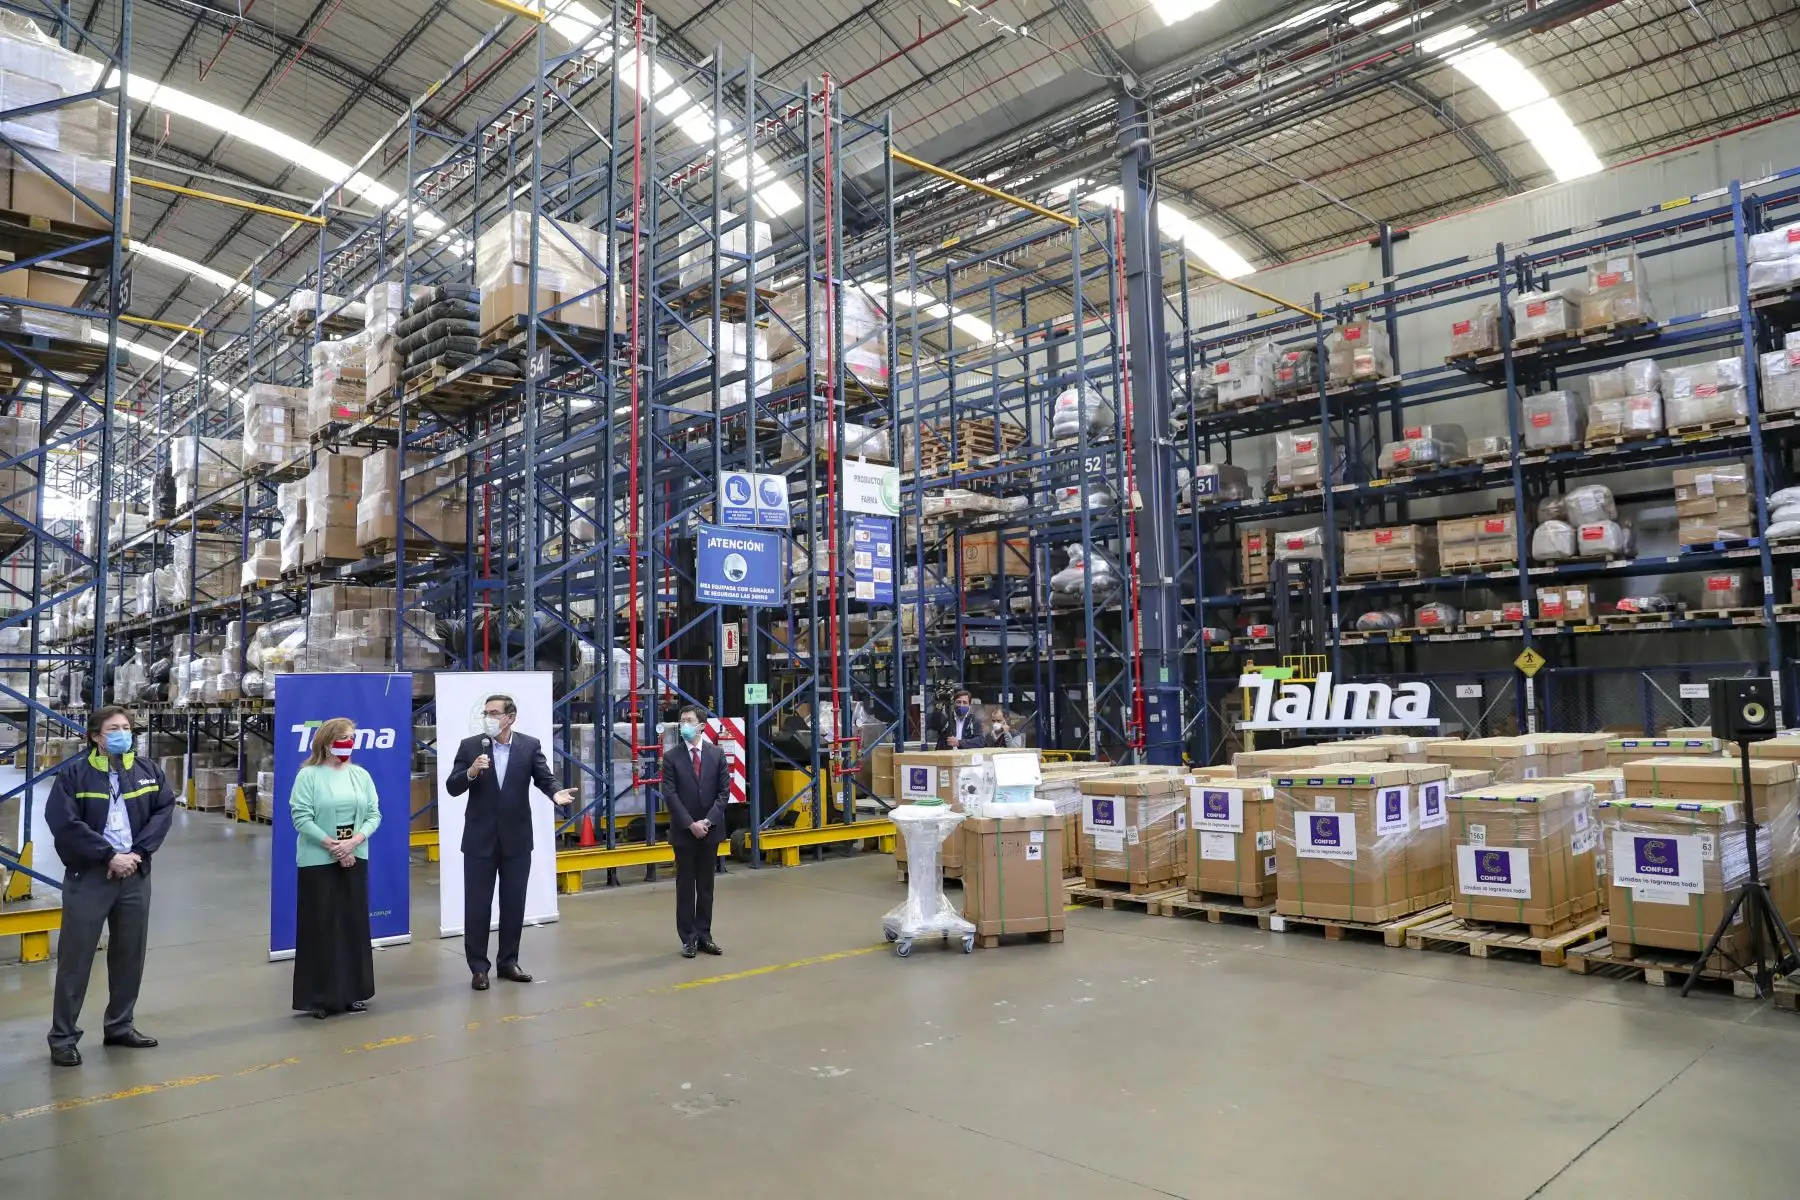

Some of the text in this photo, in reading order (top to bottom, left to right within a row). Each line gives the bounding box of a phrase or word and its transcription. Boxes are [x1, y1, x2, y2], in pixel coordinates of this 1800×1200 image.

[119, 278, 129, 308] 55
[529, 349, 544, 378] 54
[1085, 456, 1101, 472] 52
[1197, 478, 1212, 492] 51
[708, 537, 764, 552] ¡ATENCIÓN!
[1238, 668, 1431, 723] Talma
[290, 720, 396, 752] Tma
[1651, 878, 1680, 887] logramos
